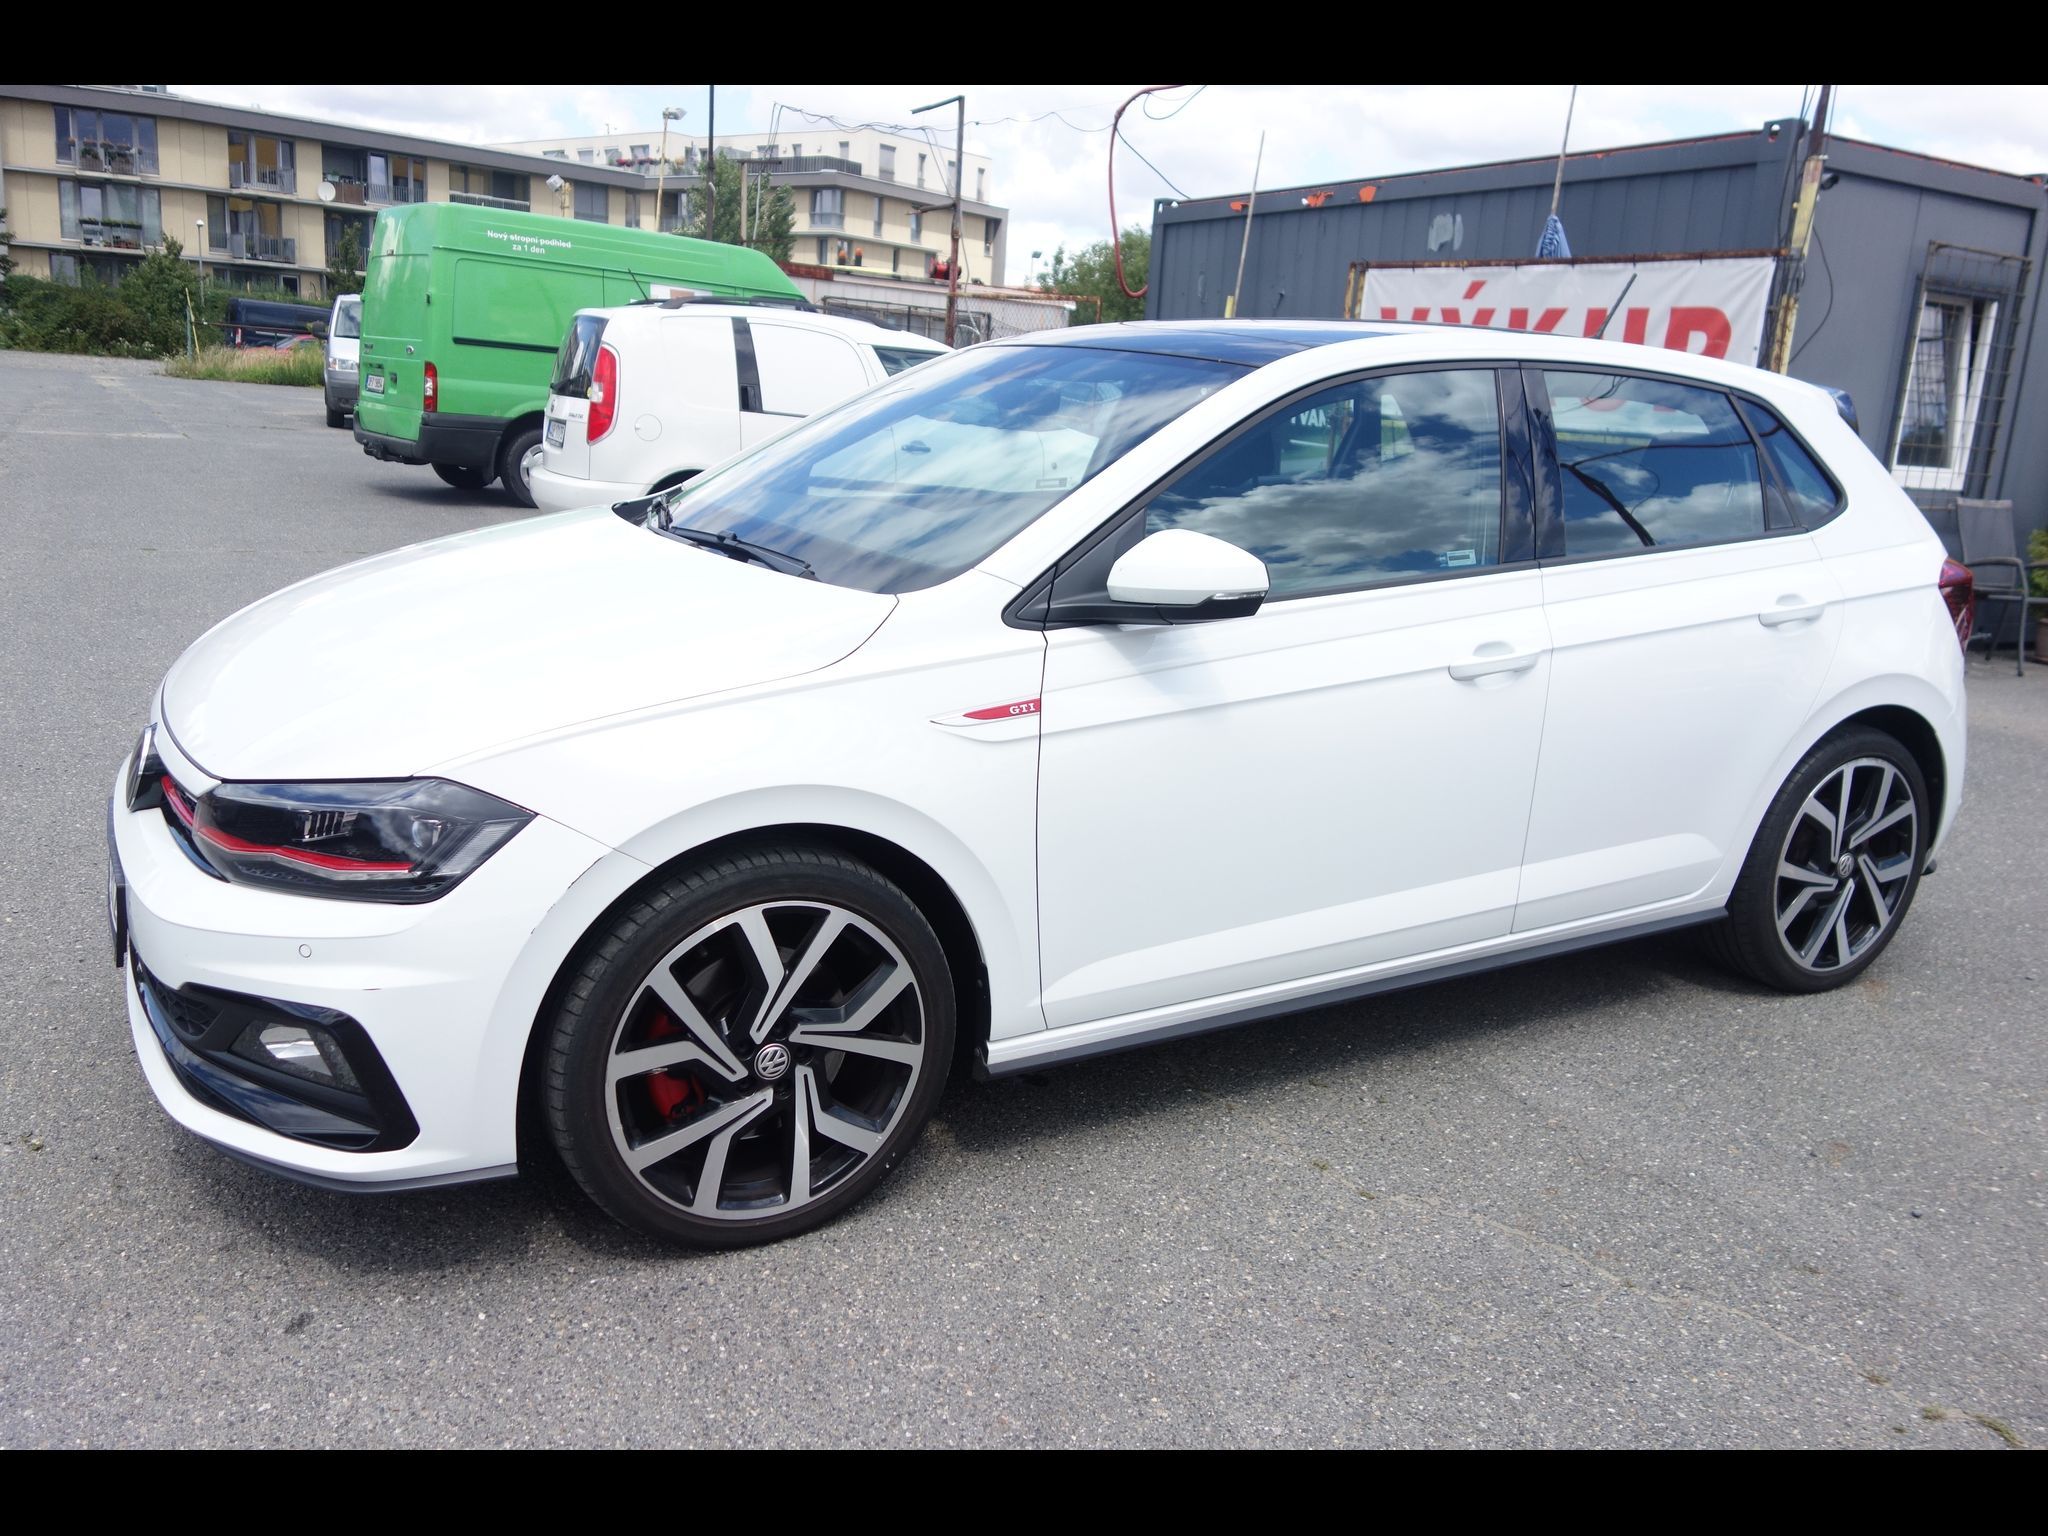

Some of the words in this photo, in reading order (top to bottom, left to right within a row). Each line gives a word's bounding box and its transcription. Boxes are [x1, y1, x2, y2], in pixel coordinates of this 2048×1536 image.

[487, 230, 508, 241] Nový
[540, 238, 571, 248] podhled
[523, 244, 528, 252] 1
[530, 245, 545, 254] den
[1009, 703, 1035, 714] GTI
